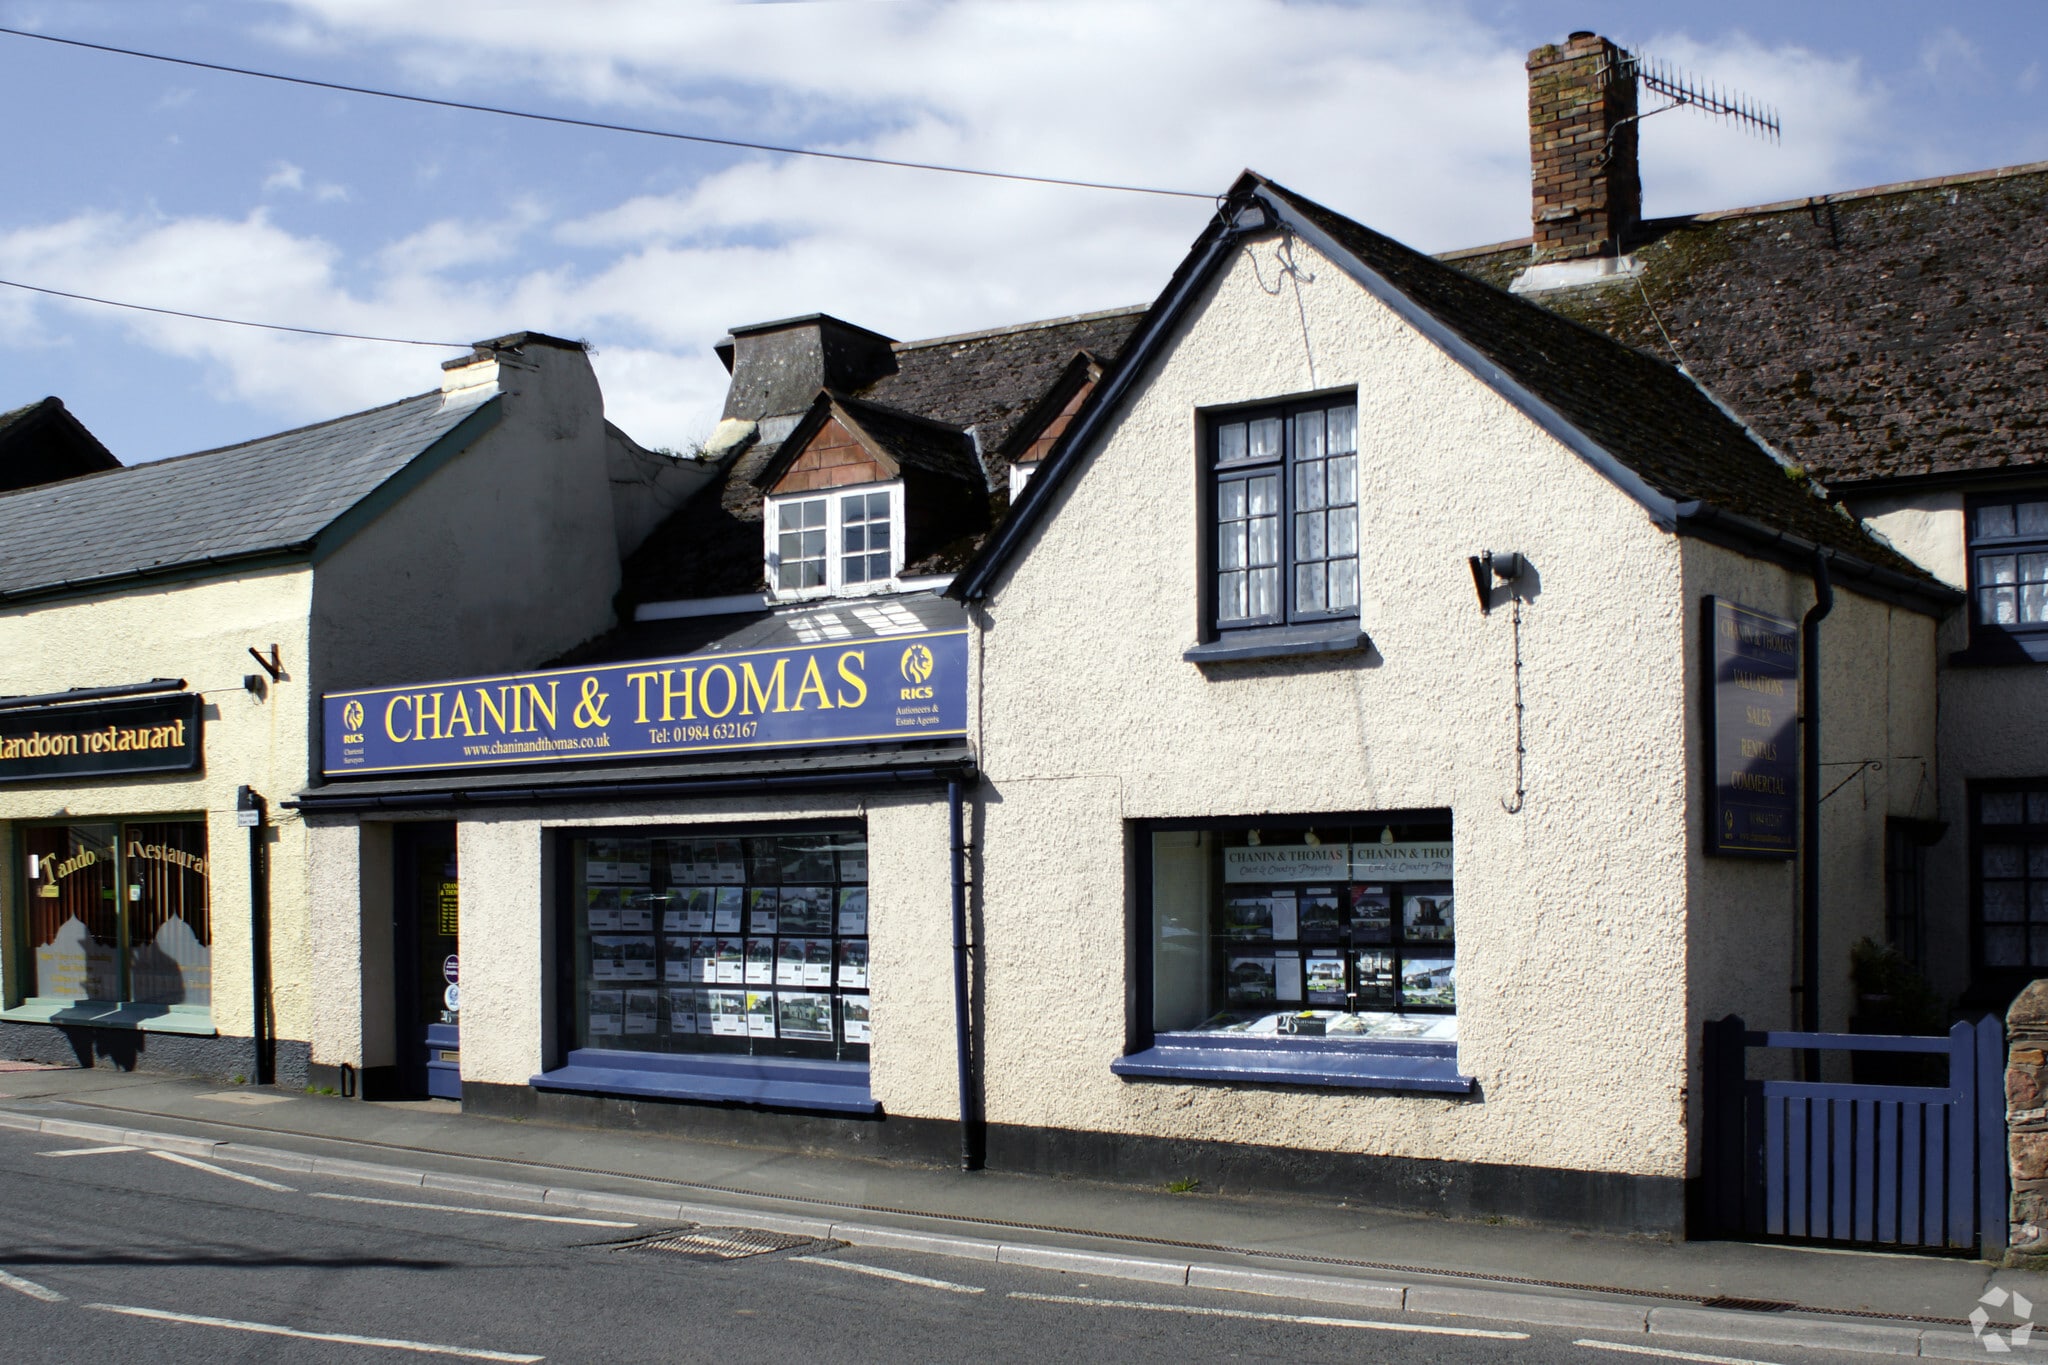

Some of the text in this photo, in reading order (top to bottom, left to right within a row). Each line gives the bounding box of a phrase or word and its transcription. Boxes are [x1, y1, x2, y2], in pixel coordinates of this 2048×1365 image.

[900, 686, 934, 700] RICS
[1733, 668, 1784, 697] VALUATIONS
[384, 650, 868, 743] CHANIN & THOMAS
[932, 703, 939, 713] &
[895, 716, 940, 727] Estate Agents
[1746, 705, 1772, 728] SALES
[82, 719, 185, 753] restaurant
[343, 733, 365, 744] RICS
[463, 721, 758, 756] www.chaninandthomas.co.uk Tel: 01984 632167
[1740, 738, 1777, 761] RENTALS
[1730, 771, 1786, 796] COMMERCIAL
[1229, 849, 1343, 863] CHANIN & THOMAS
[1358, 847, 1453, 860] CHANIN & THO
